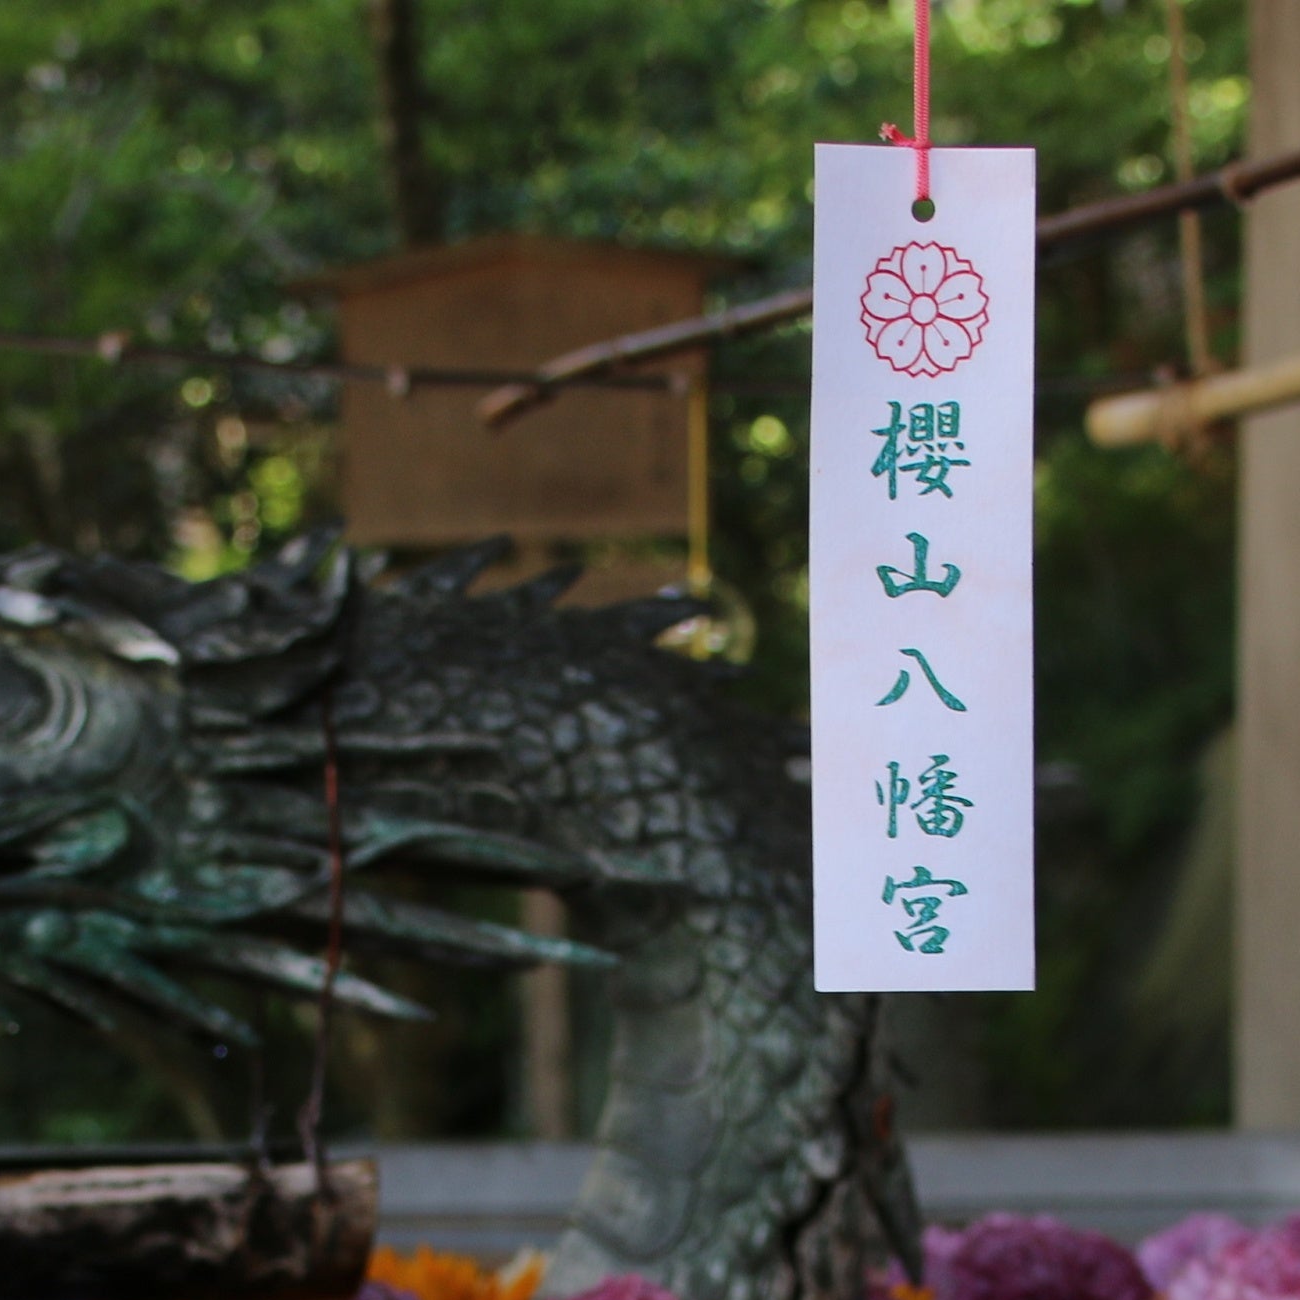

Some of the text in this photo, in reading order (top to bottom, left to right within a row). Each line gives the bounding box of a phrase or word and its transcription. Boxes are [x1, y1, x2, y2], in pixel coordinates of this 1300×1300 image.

[871, 400, 973, 954] 櫻山八幡宮
